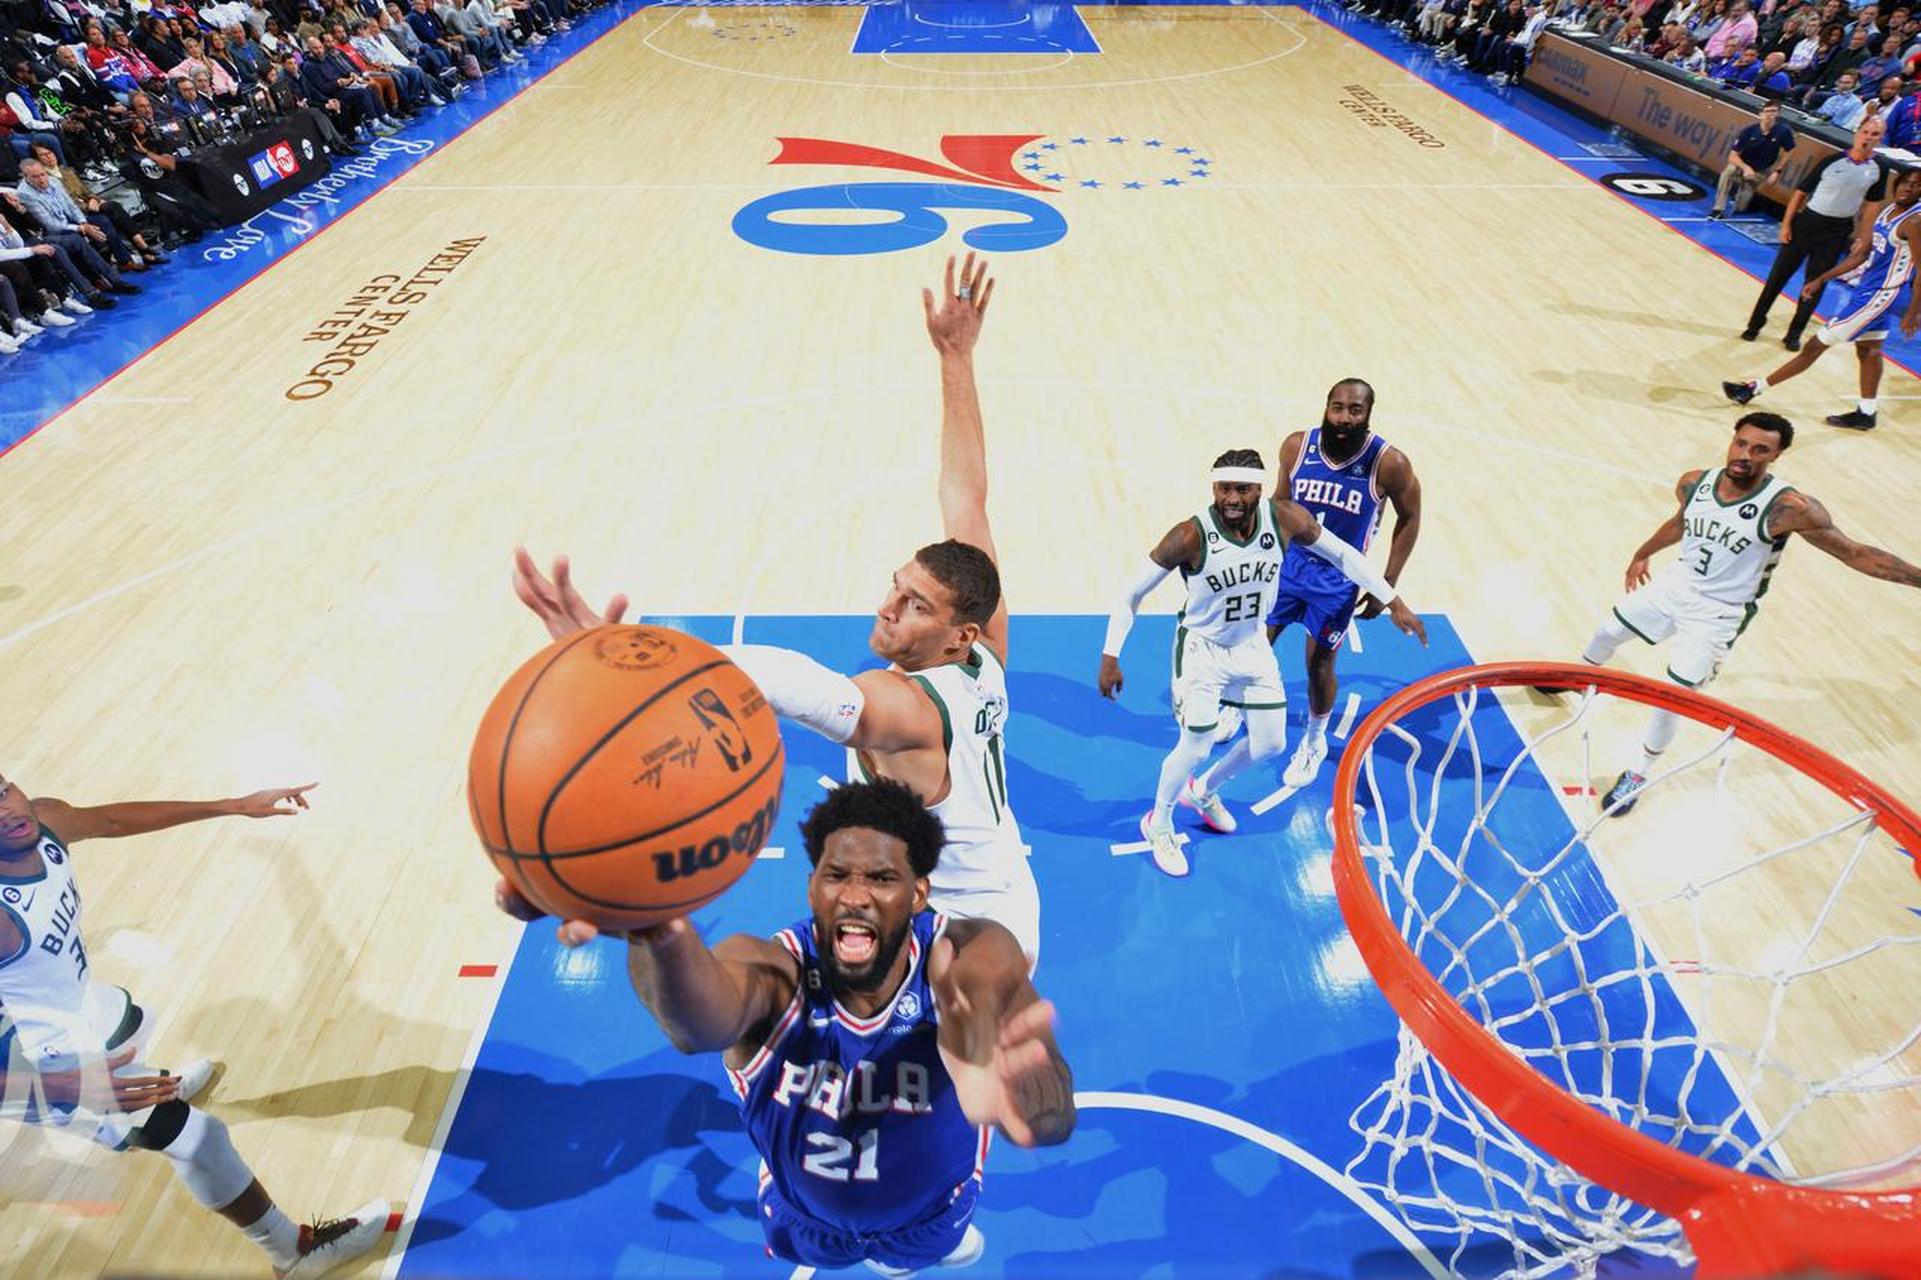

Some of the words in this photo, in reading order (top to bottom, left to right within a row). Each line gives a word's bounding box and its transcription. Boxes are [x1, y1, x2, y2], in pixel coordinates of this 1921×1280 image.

[1637, 86, 1671, 129] The
[1676, 112, 1720, 160] way
[283, 137, 434, 209] Brotherly
[1612, 179, 1693, 195] 6
[204, 208, 313, 261] Love
[388, 235, 487, 305] WELLS
[303, 274, 400, 341] CENTER
[285, 310, 410, 401] FARGO
[1294, 478, 1363, 515] PHILA
[1684, 517, 1752, 555] BUCKS
[1694, 547, 1713, 577] 3
[1206, 561, 1279, 593] BUCKS
[1225, 592, 1261, 622] 23
[40, 877, 81, 956] BUCK
[772, 1059, 933, 1121] PHILA
[803, 1128, 879, 1181] 21
